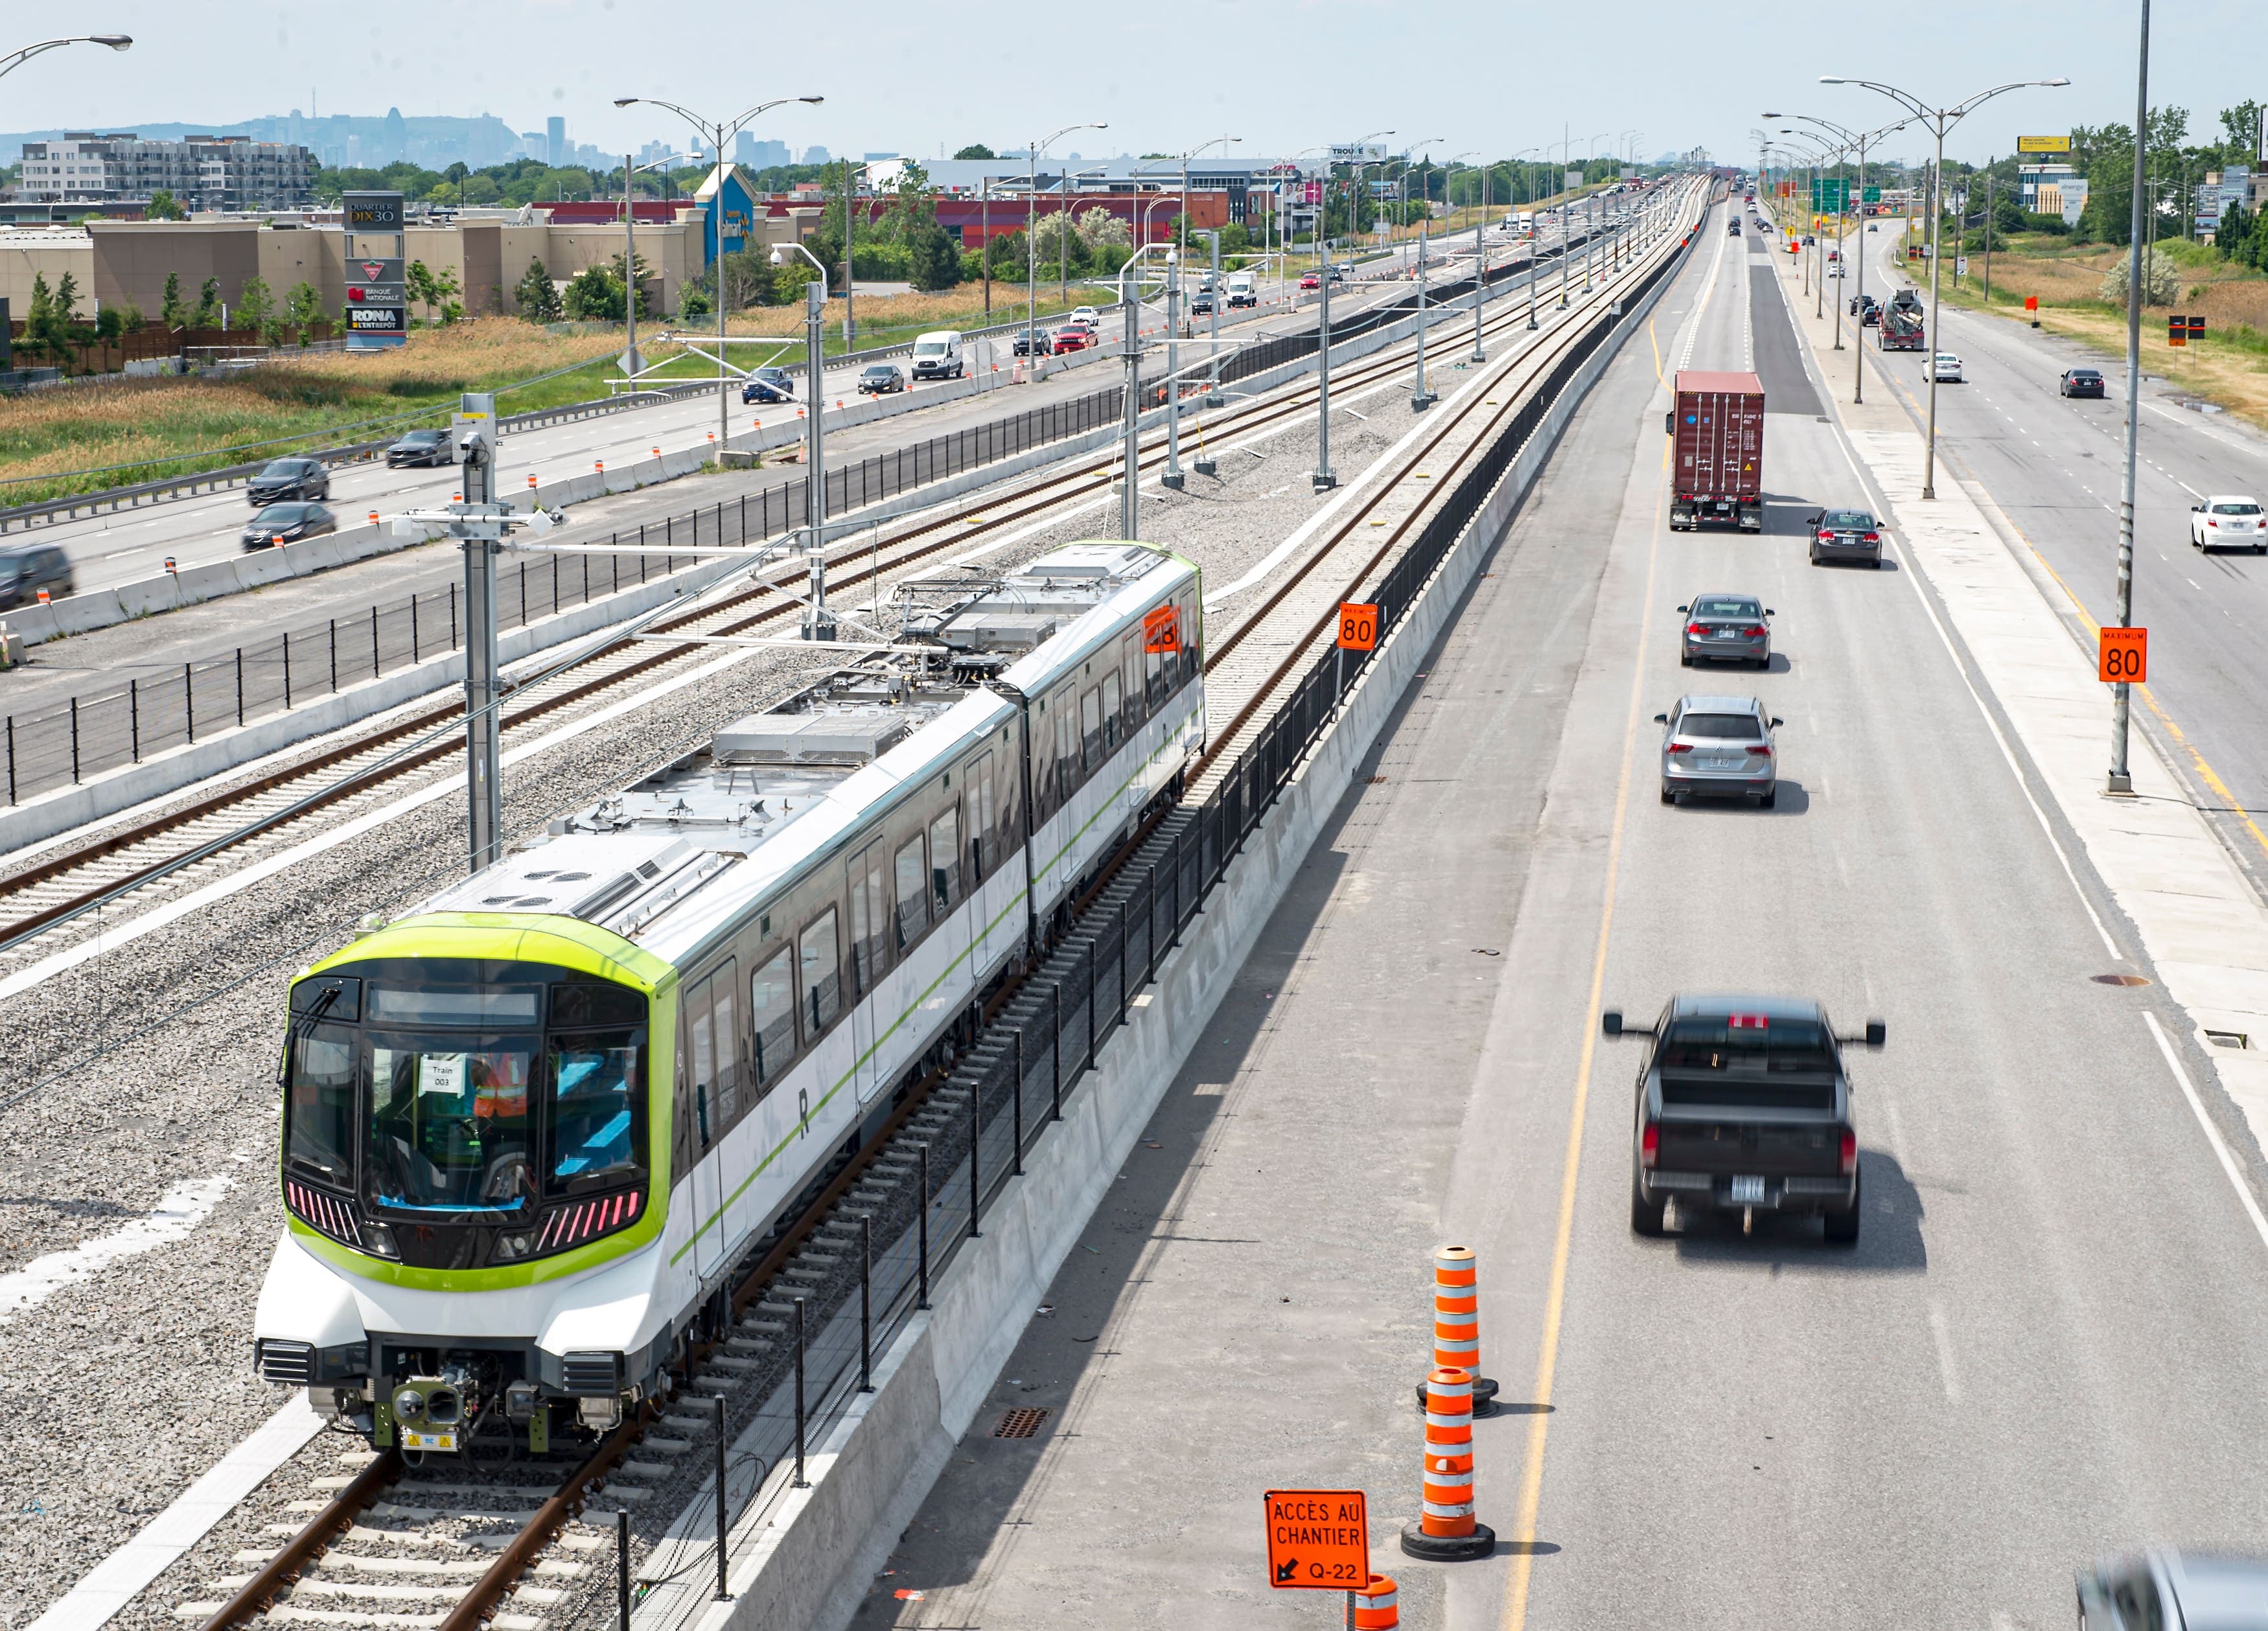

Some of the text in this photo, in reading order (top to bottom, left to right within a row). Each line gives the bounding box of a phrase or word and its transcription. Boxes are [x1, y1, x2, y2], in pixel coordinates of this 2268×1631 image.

[350, 211, 394, 222] DIX30
[352, 310, 396, 321] RONA
[1343, 619, 1371, 642] 80
[2107, 648, 2140, 676] 80
[1273, 1499, 1360, 1522] ACCÈS AU
[1277, 1526, 1360, 1546] CHANTIER
[1310, 1562, 1357, 1580] Q-22
